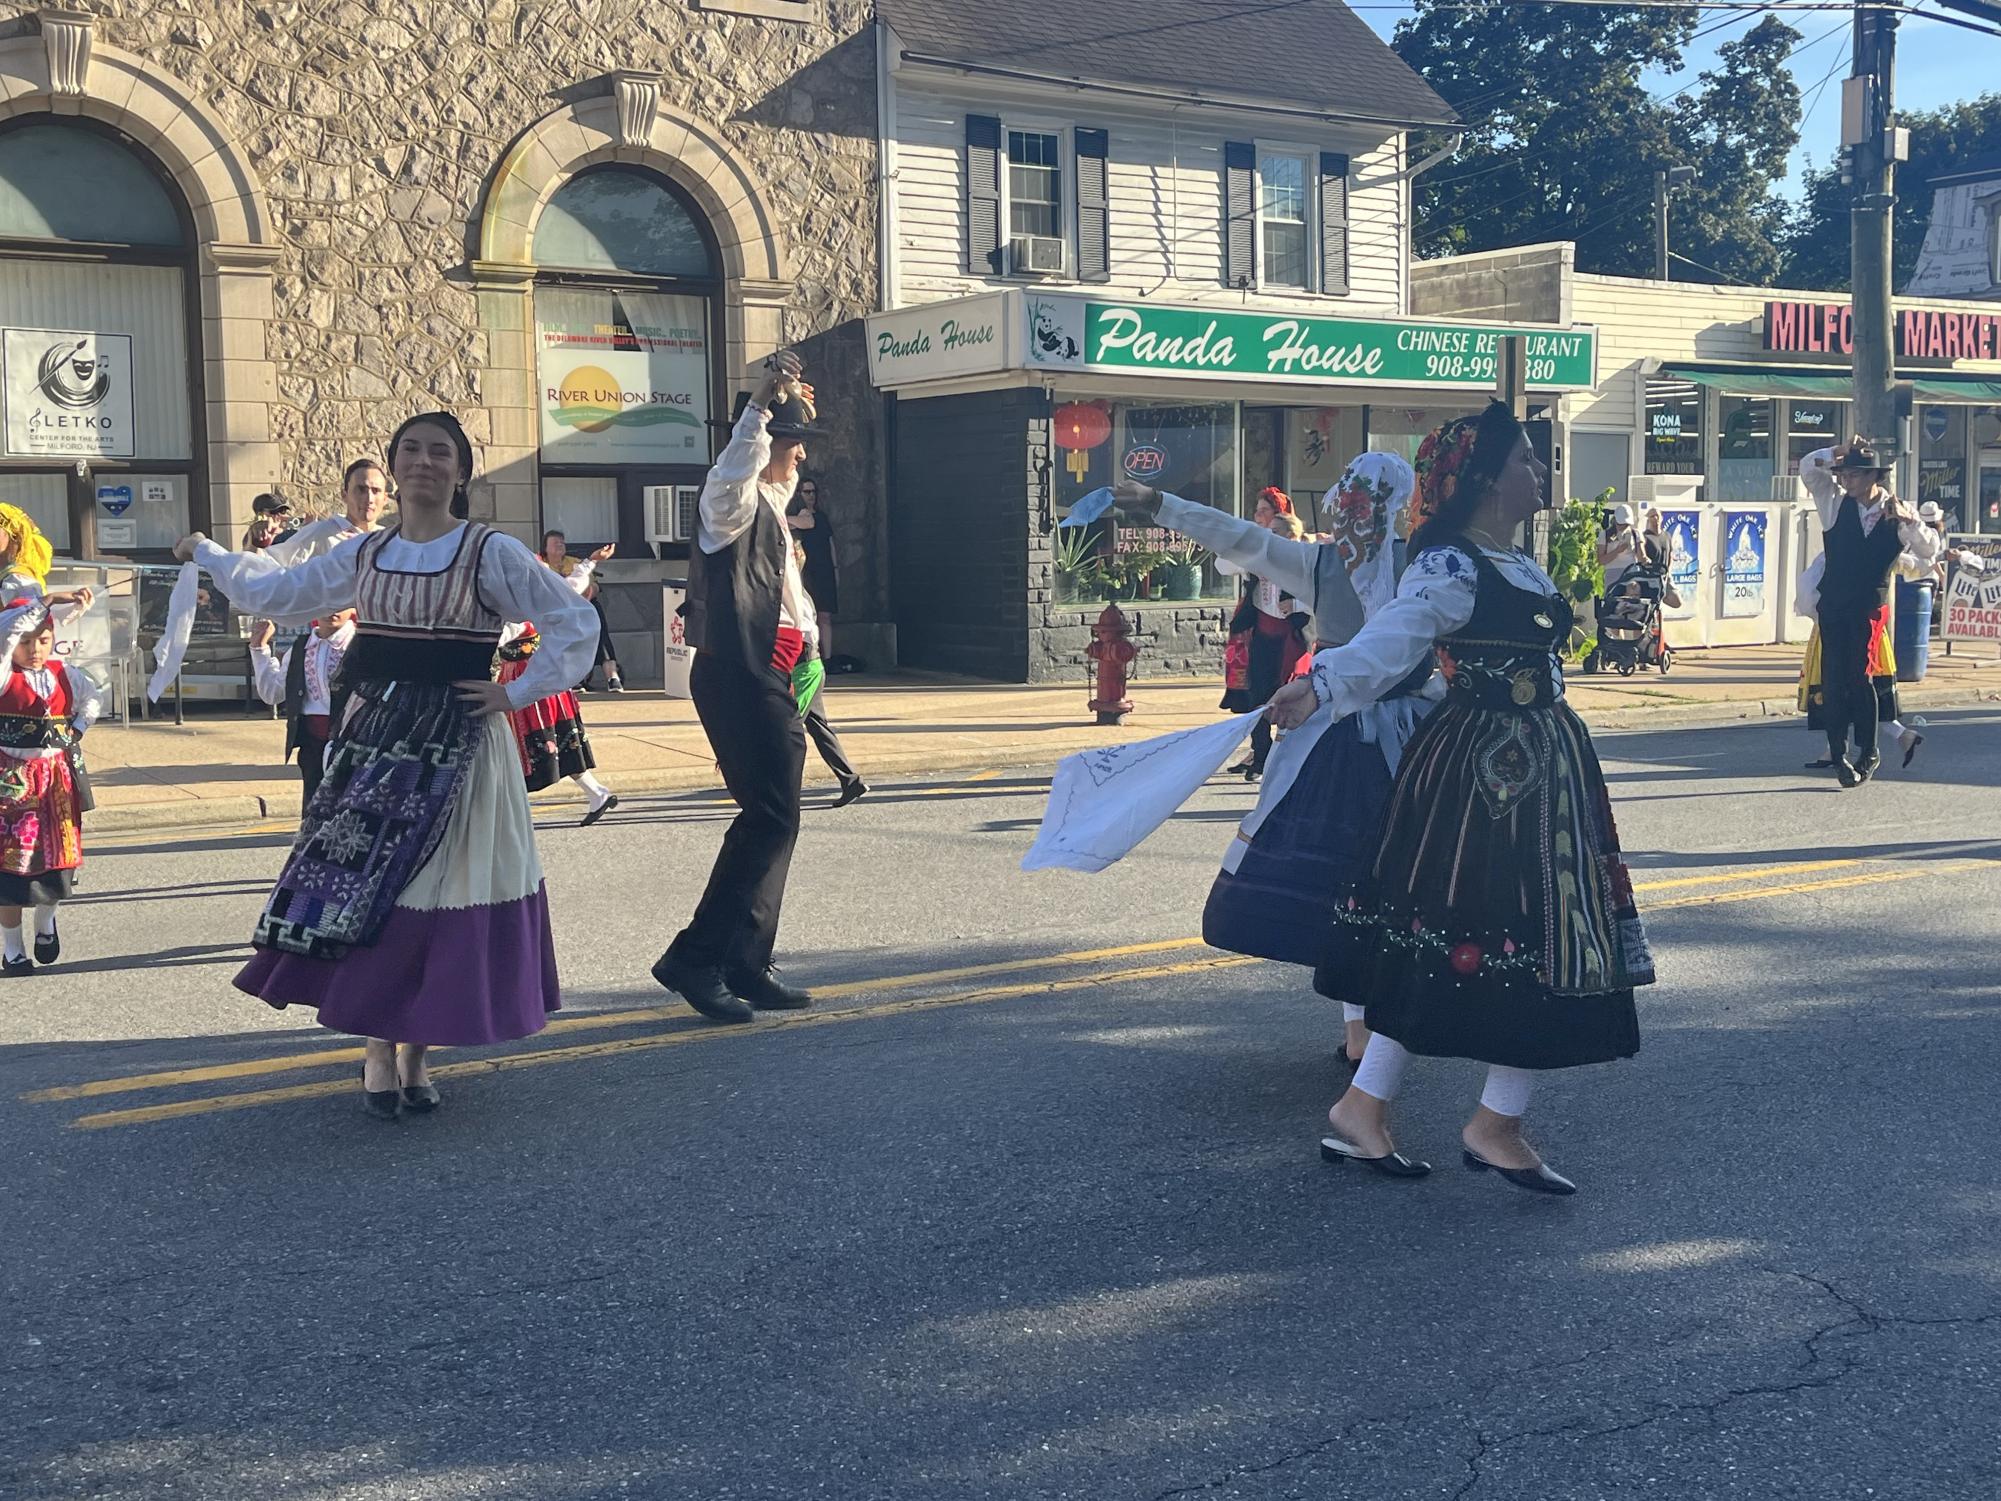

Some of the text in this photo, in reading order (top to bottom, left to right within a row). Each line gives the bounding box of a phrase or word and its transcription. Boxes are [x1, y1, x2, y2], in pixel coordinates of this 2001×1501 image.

[1771, 301, 1853, 354] MILFO
[877, 320, 994, 362] Panda House
[1095, 308, 1384, 376] Panda House
[1397, 329, 1582, 357] CHINESE REURANT
[547, 389, 692, 405] RIVER UNION STAGE
[1653, 414, 1681, 428] KONA
[1653, 427, 1681, 436] BIG WAVE
[1125, 451, 1165, 469] OPEN
[1647, 462, 1675, 474] REWARD
[1920, 467, 1960, 497] Miller
[1940, 485, 1960, 498] TIME
[1983, 557, 2001, 570] TIM
[1681, 574, 1697, 583] BAGS
[1727, 573, 1762, 582] LARGE BAGS
[1950, 608, 2001, 625] 30 PACK
[1947, 623, 2001, 639] AVAILABL
